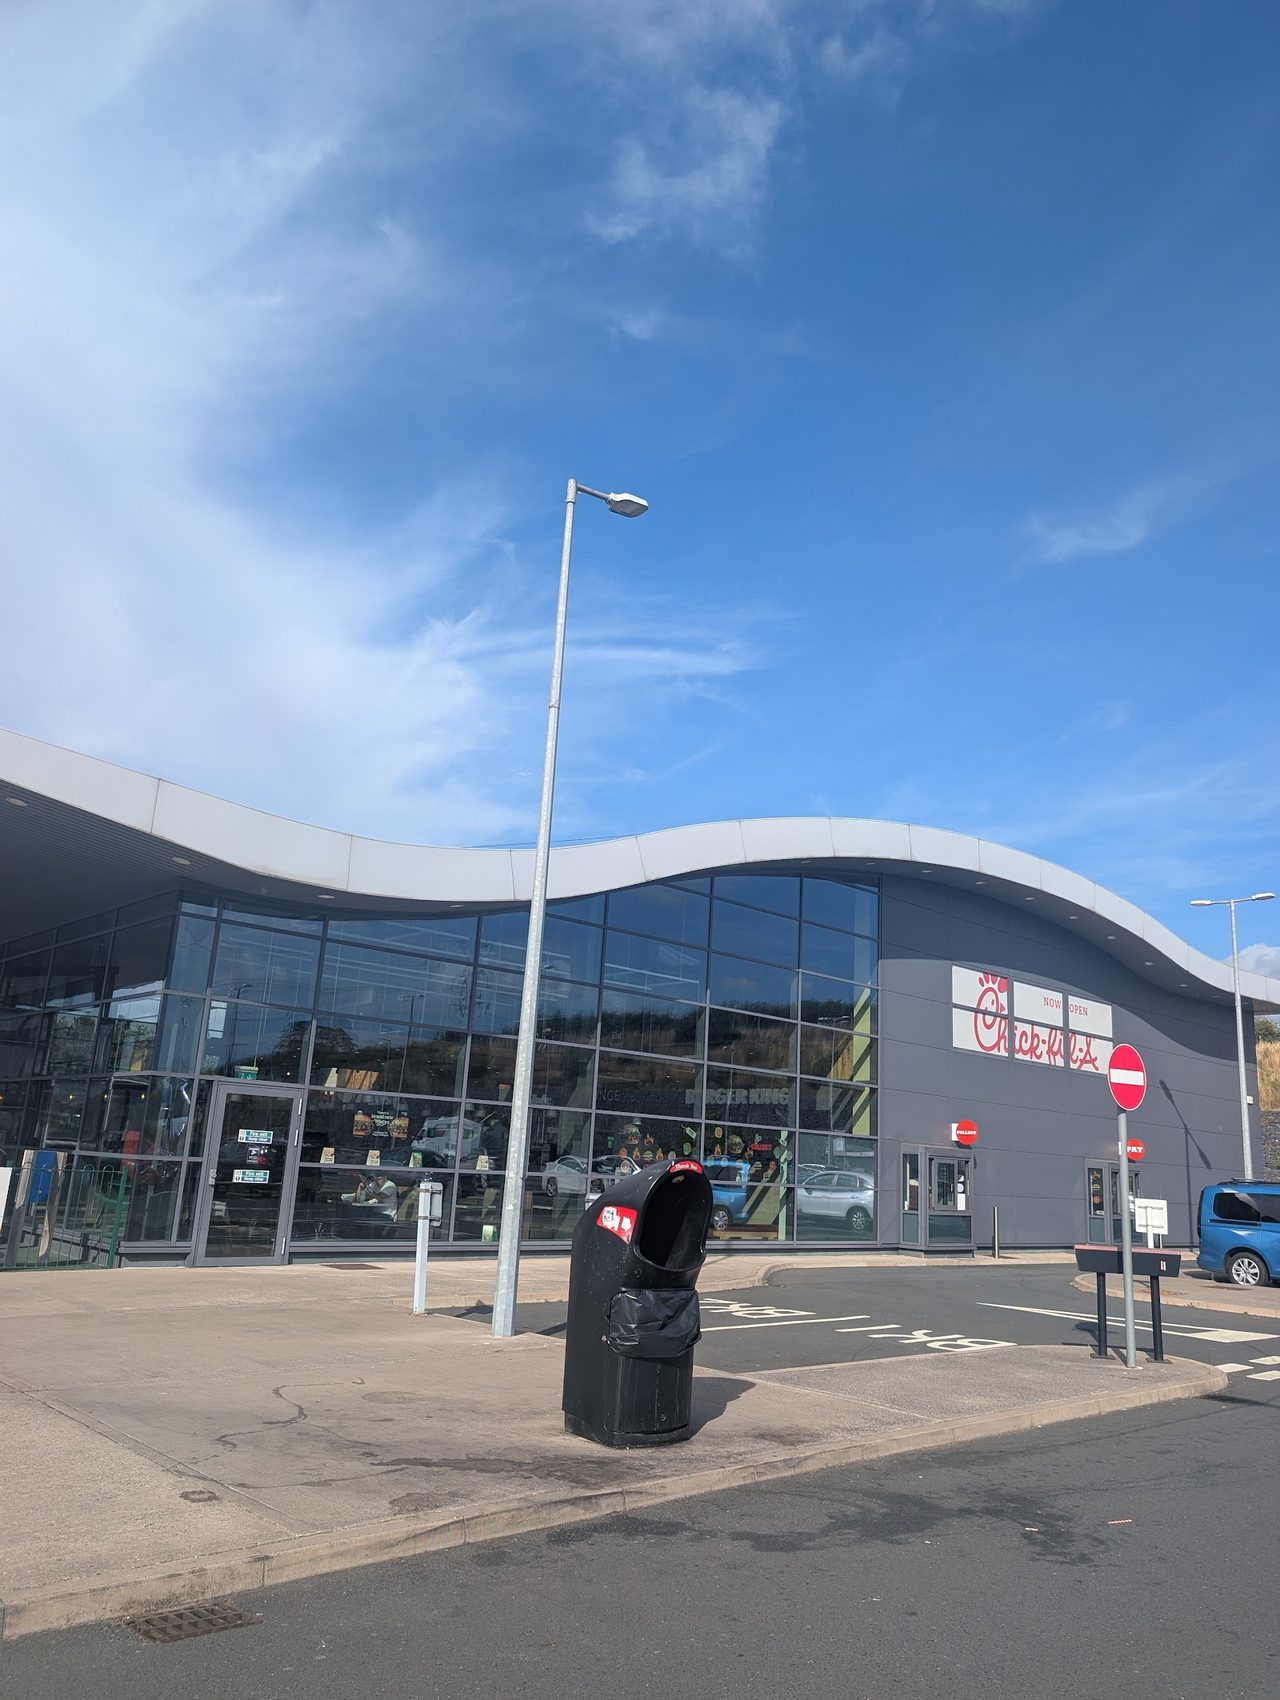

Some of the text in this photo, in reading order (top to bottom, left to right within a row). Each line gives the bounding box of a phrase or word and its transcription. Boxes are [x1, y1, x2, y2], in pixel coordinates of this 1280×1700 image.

[1043, 996, 1088, 1017] NOW OPEN
[685, 1088, 790, 1104] BRGER KING
